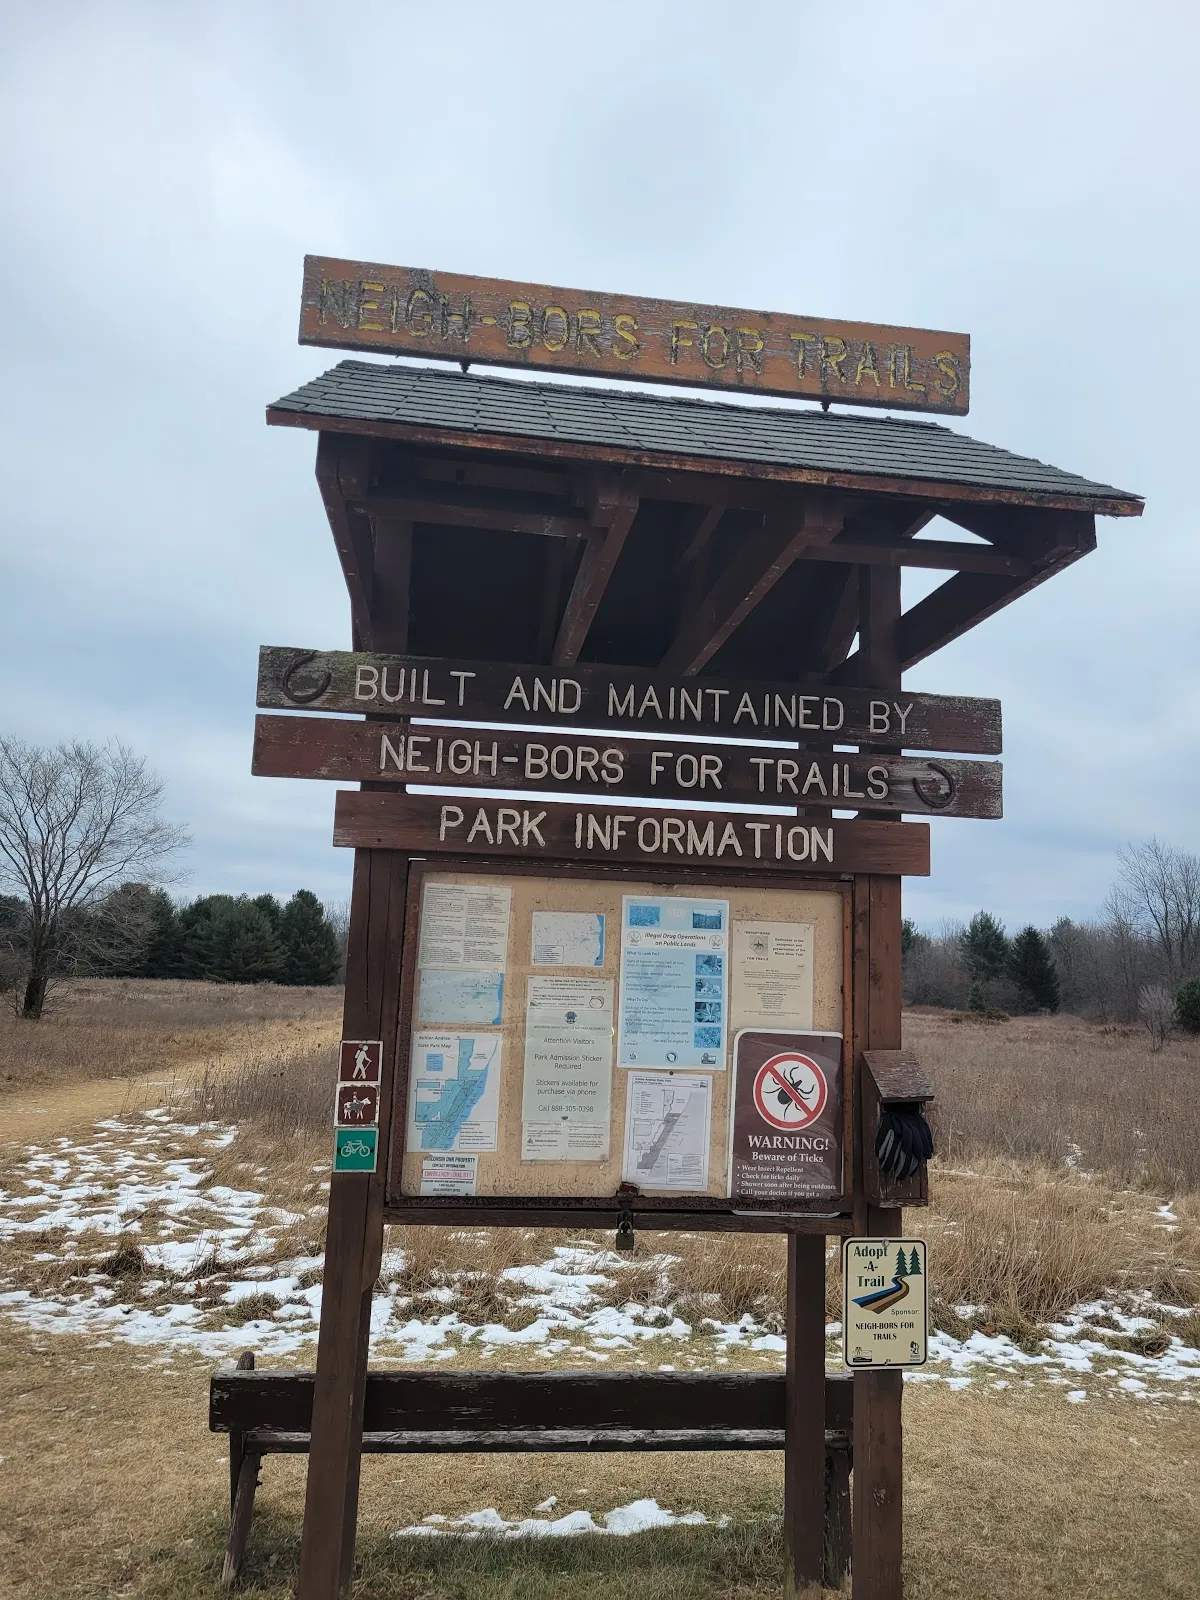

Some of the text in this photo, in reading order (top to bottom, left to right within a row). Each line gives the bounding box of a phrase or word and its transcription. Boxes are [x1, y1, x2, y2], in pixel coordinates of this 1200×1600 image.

[319, 278, 961, 400] NEIGH-BORS FOR TRAILS
[354, 665, 913, 734] BUILT AND MAINTAINED BY
[379, 734, 889, 800] NEIGH-BORS FOR TRAILS
[440, 805, 834, 863] PARK INFORMATION
[663, 933, 677, 941] Drug
[677, 933, 706, 941] Operations
[573, 1037, 595, 1045] Visitors
[549, 1053, 580, 1061] Admission
[581, 1054, 602, 1062] Sticker
[554, 1062, 582, 1071] Required
[561, 1079, 588, 1087] available
[537, 1088, 565, 1096] purchase
[577, 1089, 597, 1097] phone
[537, 1104, 550, 1112] Call
[748, 1135, 829, 1150] WARNING!
[752, 1151, 824, 1163] Beware of Ticks
[758, 1164, 775, 1172] Insect
[776, 1165, 803, 1174] Repellent
[785, 1174, 800, 1182] daily
[793, 1182, 810, 1190] being
[854, 1245, 888, 1259] Adopt
[864, 1261, 878, 1272] -A-
[857, 1275, 885, 1287] Trail
[855, 1321, 914, 1330] NEIGH-BORS FOR
